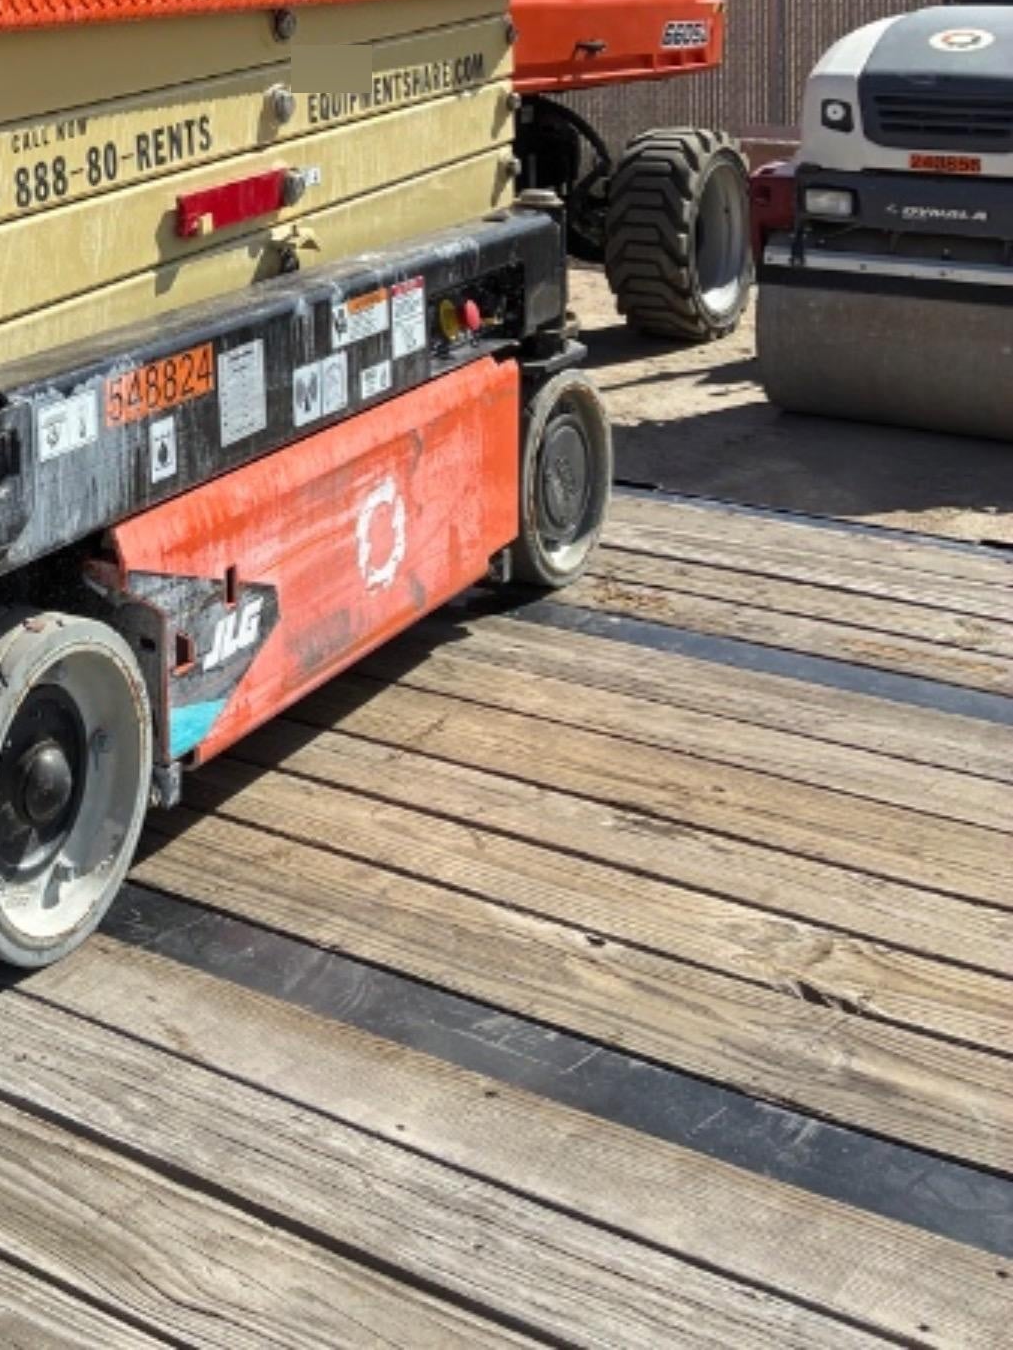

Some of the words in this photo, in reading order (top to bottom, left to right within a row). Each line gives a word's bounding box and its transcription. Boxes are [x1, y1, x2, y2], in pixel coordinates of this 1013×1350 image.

[11, 128, 50, 153] CALL
[14, 115, 213, 208] 888-80-RENTS
[107, 347, 214, 423] 548824
[202, 597, 263, 671] JLG
